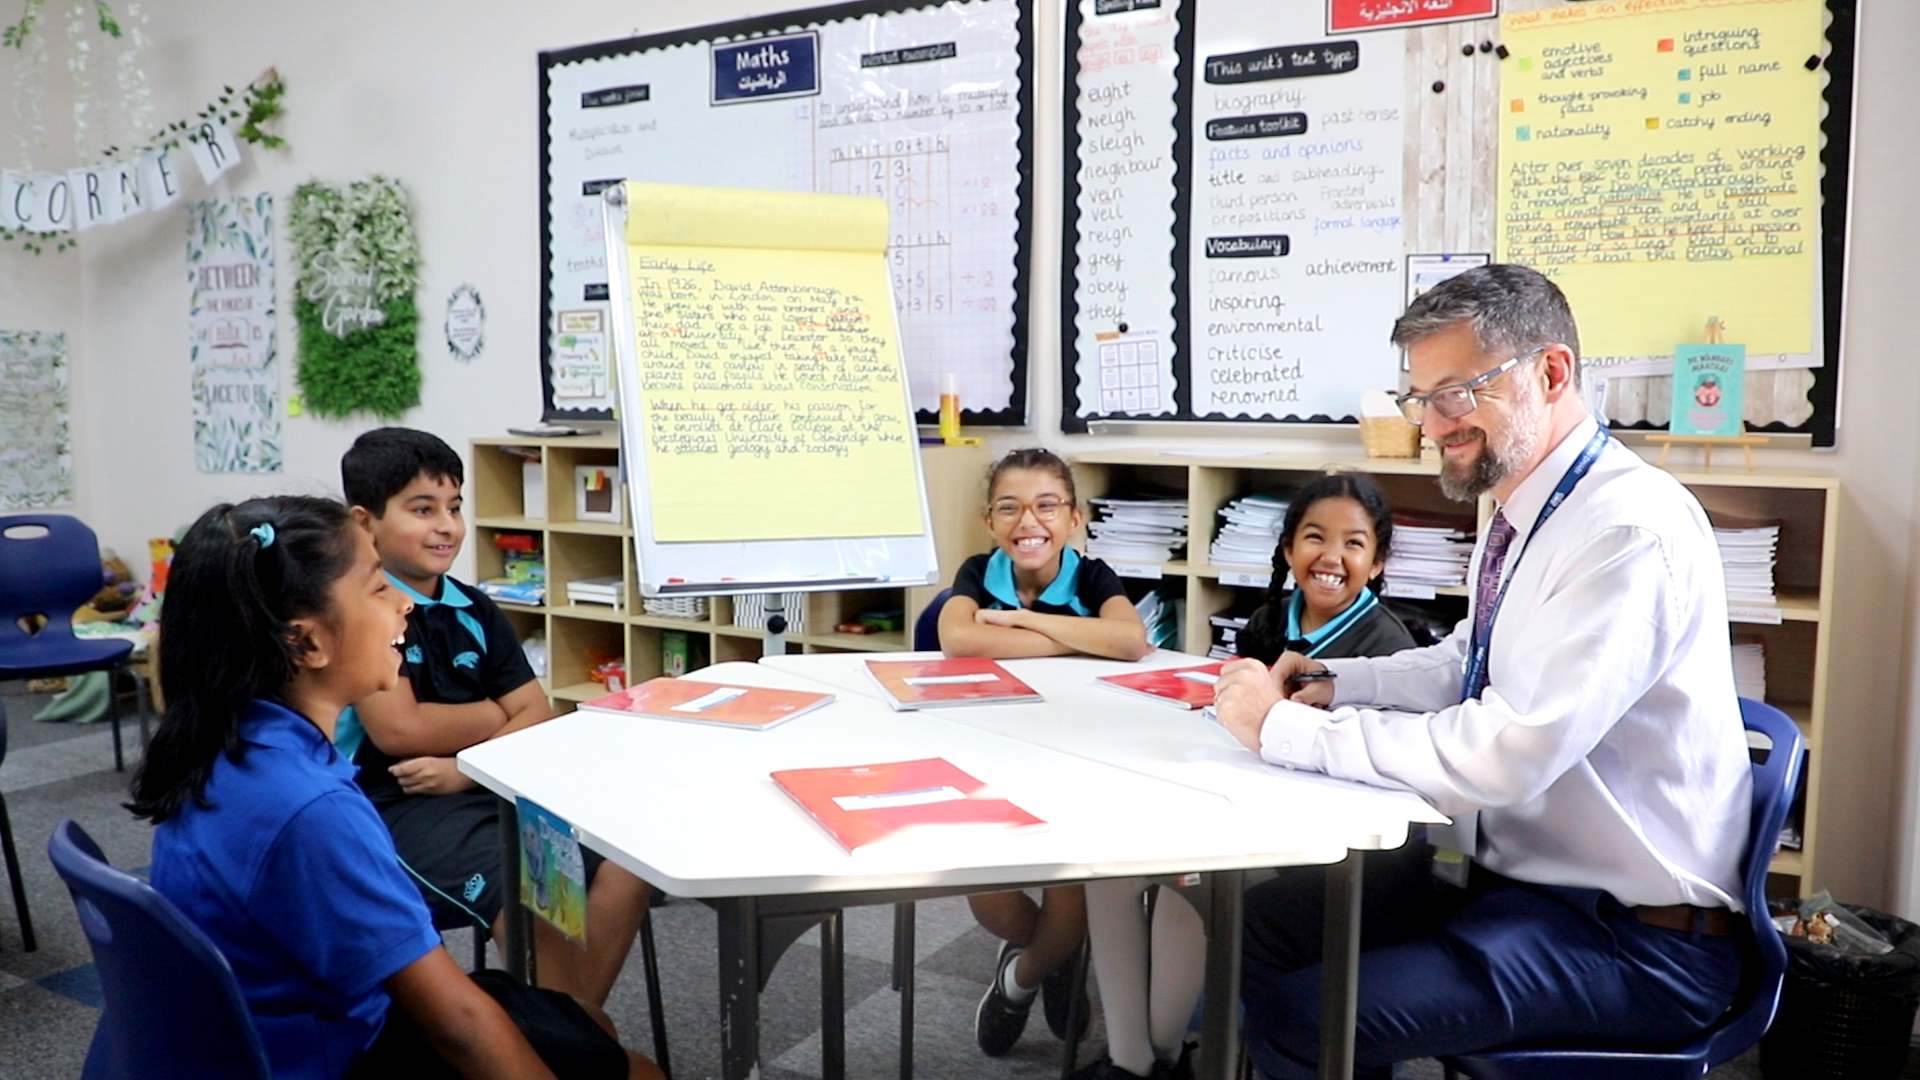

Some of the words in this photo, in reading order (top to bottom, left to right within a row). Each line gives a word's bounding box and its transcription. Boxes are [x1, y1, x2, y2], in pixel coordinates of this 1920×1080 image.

[1683, 27, 1761, 44] intriguing
[735, 45, 790, 71] Maths
[1541, 41, 1602, 58] emotive
[1683, 40, 1760, 57] questions
[1208, 61, 1243, 77] This
[1248, 53, 1284, 73] unit's
[1291, 51, 1317, 66] text
[1543, 53, 1614, 70] adjectives
[1699, 63, 1728, 81] full
[1738, 61, 1782, 75] name
[1541, 67, 1565, 80] and
[1570, 66, 1604, 78] verbs
[1088, 81, 1131, 107] eight
[1215, 88, 1306, 113] biography
[1538, 90, 1584, 105] thought
[1697, 90, 1722, 108] job
[1321, 108, 1354, 125] past
[1560, 103, 1594, 119] facts
[1725, 111, 1772, 127] ending
[1209, 121, 1256, 138] Features
[1259, 116, 1301, 132] toolkit
[1536, 123, 1611, 141] nationality
[1089, 129, 1145, 156] sleigh
[1209, 146, 1250, 169] facts
[1262, 144, 1290, 160] and
[1298, 138, 1363, 158] opinions
[1510, 161, 1550, 177] After
[1594, 159, 1632, 171] seven
[1736, 144, 1806, 161] working
[15, 123, 226, 222] CORNER
[1085, 157, 1164, 184] neighbour
[1208, 170, 1246, 187] title
[1616, 168, 1630, 180] to
[1739, 158, 1794, 171] around
[1780, 171, 1793, 181] is
[1089, 187, 1124, 204] vein
[1210, 195, 1245, 209] third
[1250, 191, 1298, 211] person
[1091, 206, 1124, 222] veil
[1671, 200, 1699, 213] and
[1770, 206, 1803, 218] over
[1212, 208, 1306, 227] prepositions
[1313, 216, 1353, 236] formal
[1088, 226, 1133, 247] reign
[1207, 238, 1282, 257] Vocabulary
[1592, 250, 1633, 263] about
[640, 256, 679, 273] Early
[688, 259, 716, 274] Life
[1088, 251, 1125, 276] grey
[1305, 258, 1398, 277] achievement
[714, 279, 752, 291] David
[1208, 266, 1281, 293] famous
[1088, 280, 1129, 302] obey
[1086, 301, 1125, 324] they
[1209, 292, 1286, 317] inspiring
[1208, 315, 1324, 337] environmental
[650, 398, 684, 411] When
[1210, 386, 1300, 406] renowned
[749, 421, 786, 432] Clare
[727, 444, 776, 459] geology
